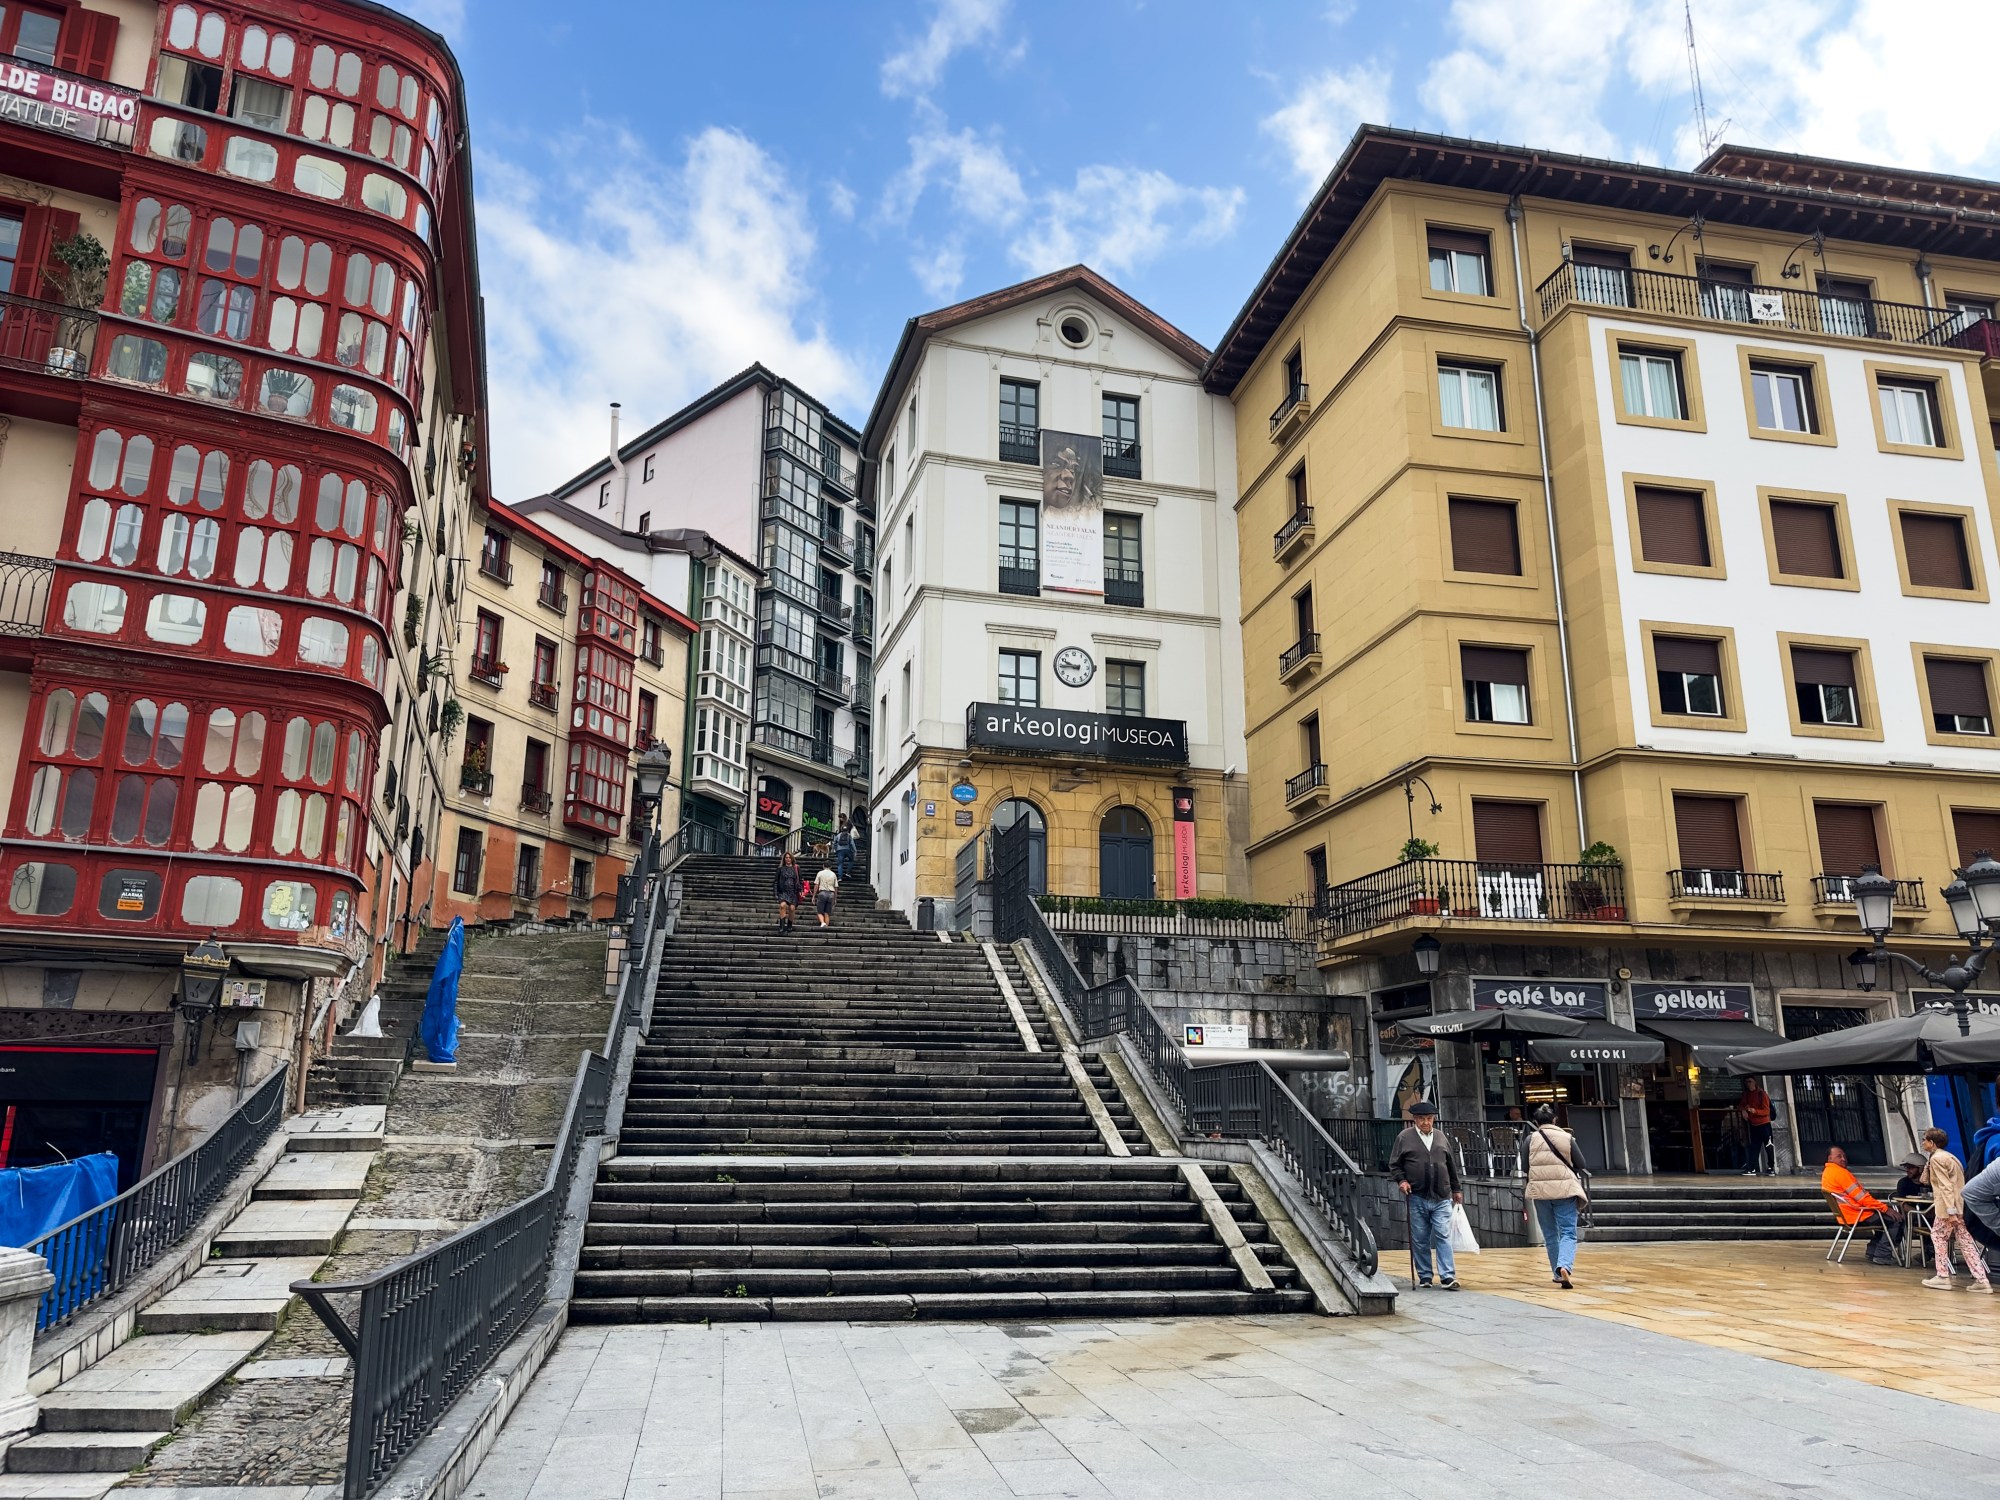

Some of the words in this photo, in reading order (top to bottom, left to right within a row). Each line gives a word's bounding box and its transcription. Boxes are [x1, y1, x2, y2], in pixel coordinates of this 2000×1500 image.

[51, 79, 135, 121] BILBAO
[759, 797, 783, 816] 97
[778, 810, 791, 819] FM
[1494, 986, 1545, 1006] café
[1550, 986, 1587, 1007] bar
[1654, 989, 1727, 1014] geltoki
[1570, 1049, 1627, 1059] GELTOKI
